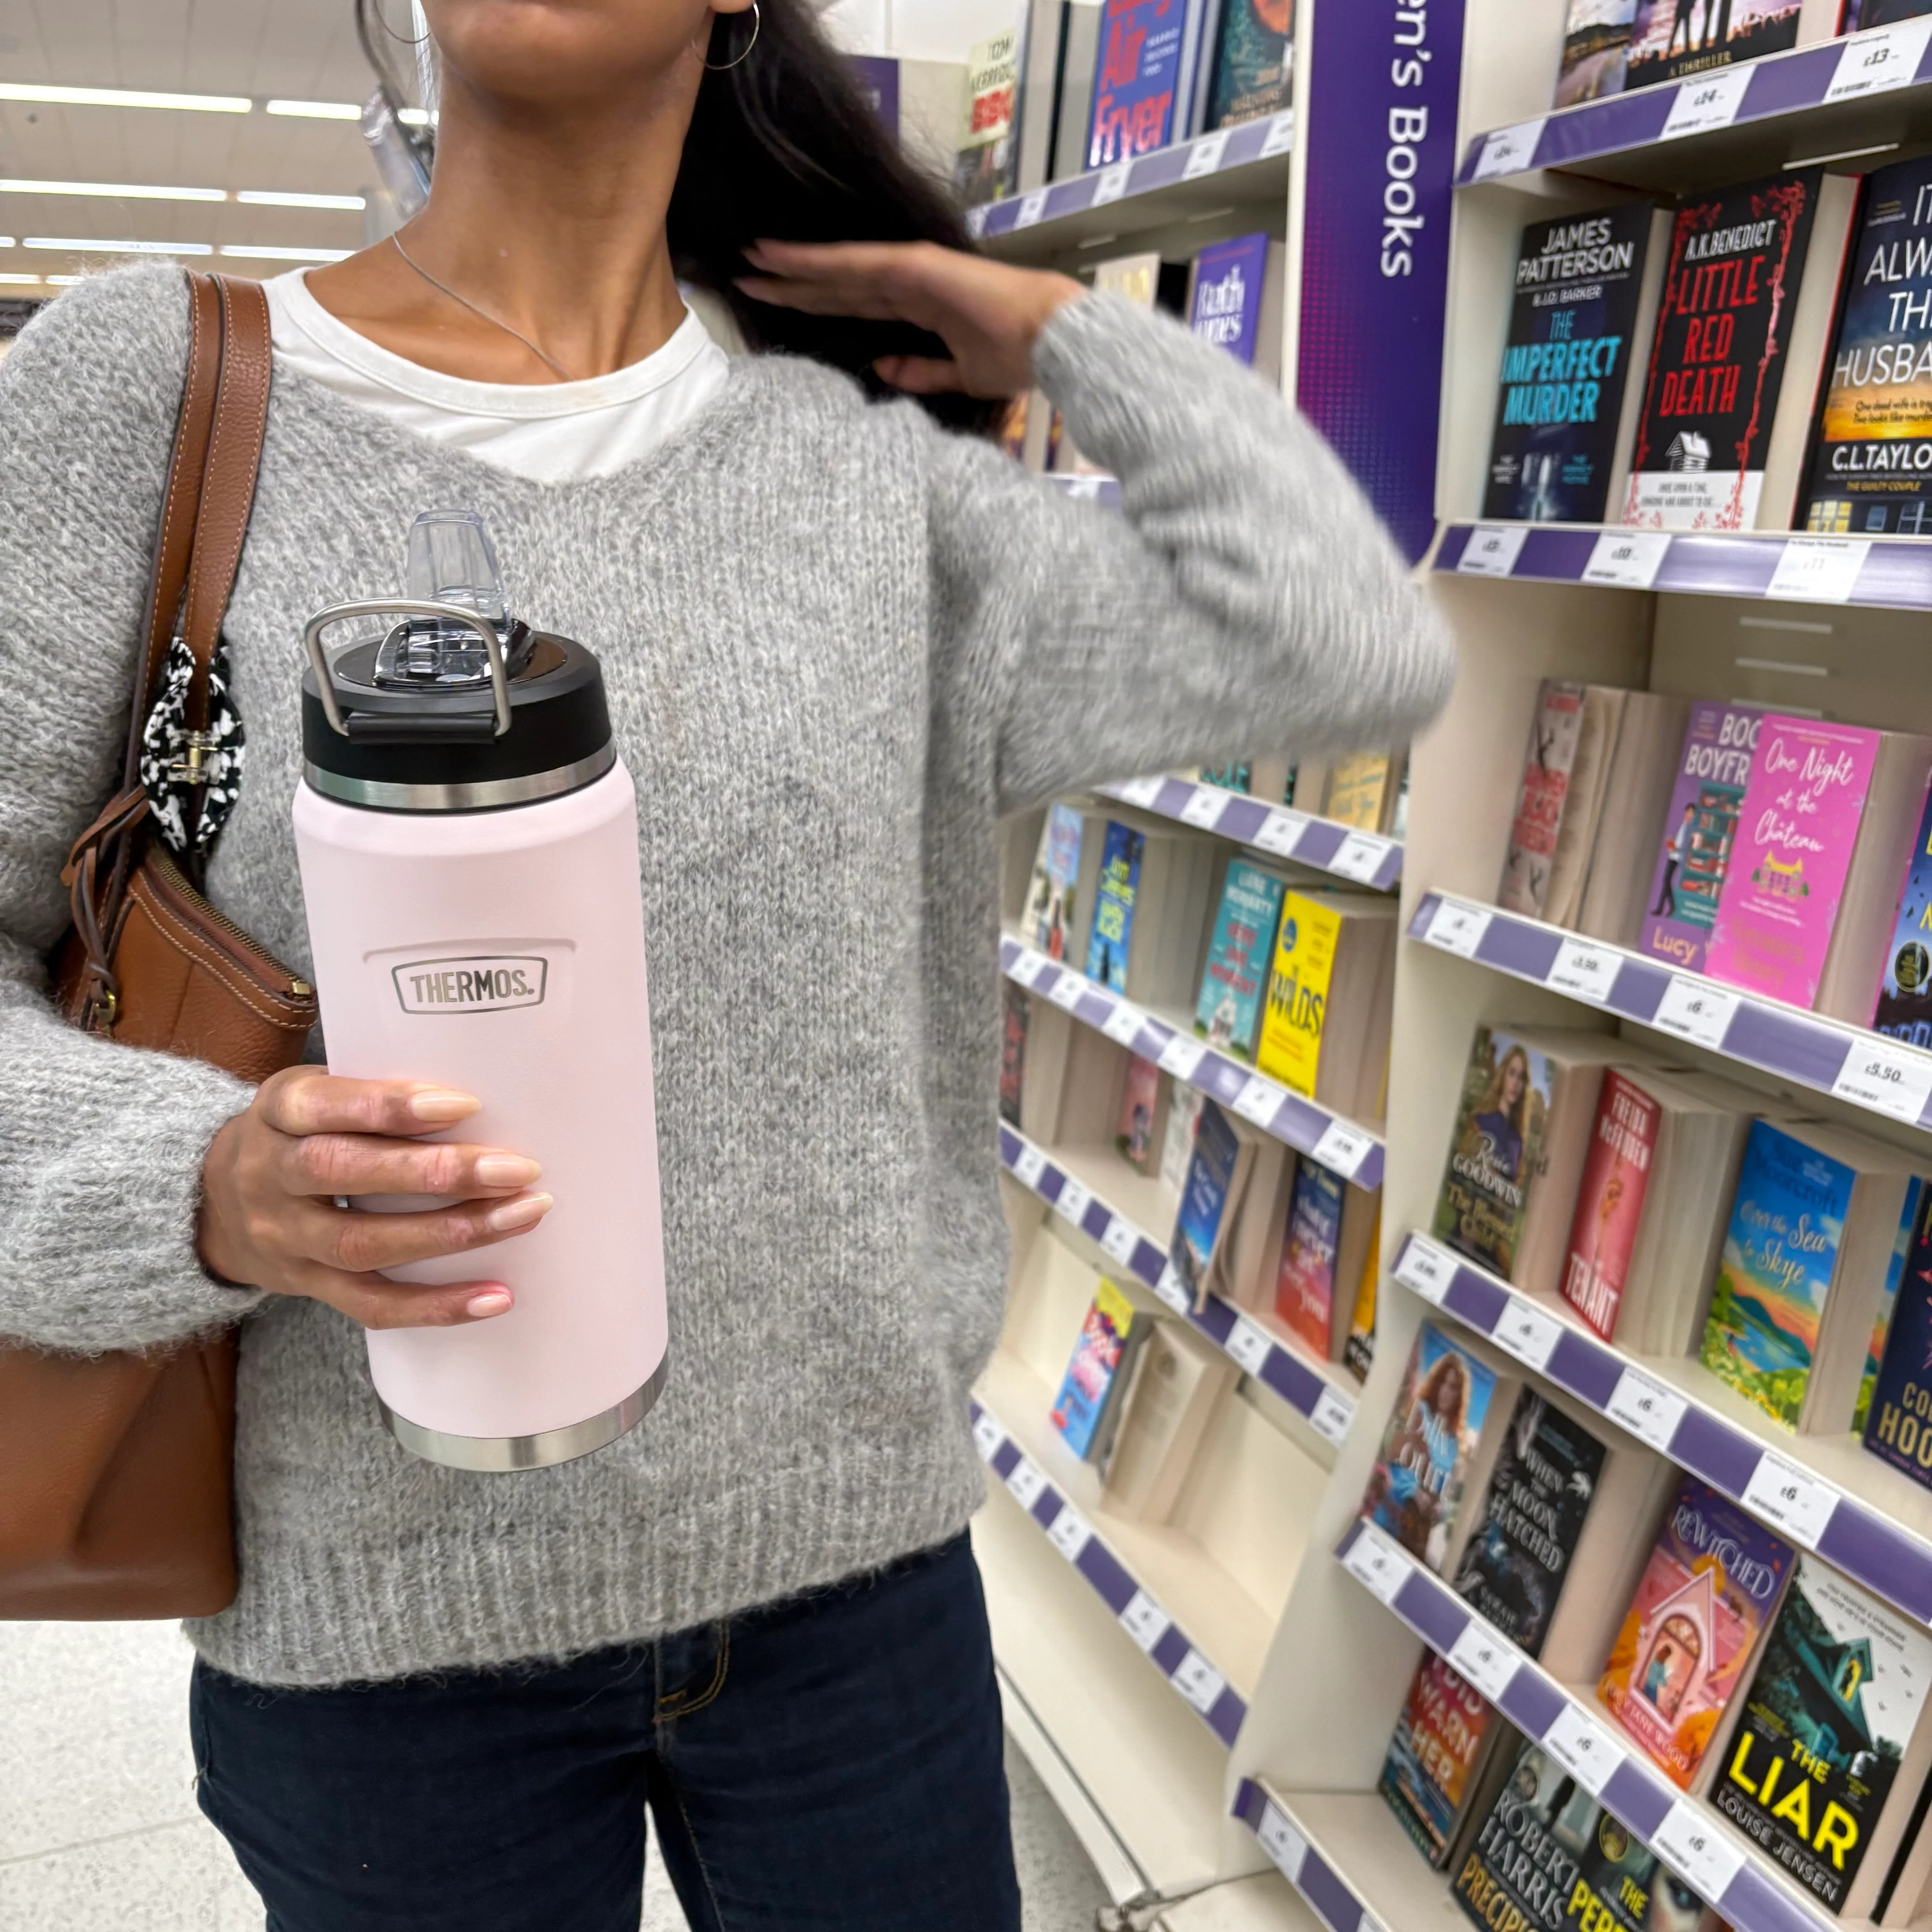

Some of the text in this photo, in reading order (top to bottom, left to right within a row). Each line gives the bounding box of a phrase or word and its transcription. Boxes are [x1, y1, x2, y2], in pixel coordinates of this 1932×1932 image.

[1100, 14, 1147, 92] Air
[1669, 51, 1732, 76] A THRILLER
[1864, 48, 1890, 67] £13
[1087, 89, 1171, 167] Fryer
[1380, 0, 1432, 278] n's Books
[1541, 217, 1613, 255] JAMES
[1516, 241, 1634, 284] PATTERSON
[1676, 255, 1766, 315] LITTLE
[1560, 284, 1603, 304] BARKER
[1889, 289, 1932, 332] TH
[1550, 310, 1575, 340] THE
[1682, 313, 1734, 364] RED
[1501, 336, 1623, 384] IMPERFECT
[1503, 381, 1600, 425] MURDER
[1659, 365, 1741, 417] DEATH
[1765, 738, 1854, 796] One Night
[1776, 788, 1817, 814] at the
[1652, 926, 1697, 965] Lucy
[1271, 970, 1323, 1039] WILDS
[1865, 1063, 1902, 1083] £5.50
[1611, 1092, 1647, 1137] FREIDA
[1453, 1153, 1522, 1208] GOODWIN
[1741, 1199, 1769, 1230] Over
[1788, 1213, 1826, 1253] Sea
[1756, 1238, 1804, 1290] Skye
[1565, 1251, 1618, 1334] TENANT
[1526, 1446, 1563, 1493] WHEN
[1780, 1485, 1798, 1501] £6
[1490, 1492, 1564, 1573] HATCHED
[1513, 1479, 1558, 1544] MOON
[1671, 1504, 1775, 1600] REWITCHED
[1417, 1670, 1480, 1766] WARN
[1630, 1705, 1654, 1733] JANE
[1655, 1729, 1691, 1771] WOOD
[1411, 1719, 1454, 1793] HER
[1791, 1739, 1831, 1785] THE
[1728, 1731, 1859, 1871] LIAR
[1495, 1790, 1578, 1894] ROBERT
[1717, 1788, 1774, 1846] LOUISE
[1772, 1842, 1840, 1902] JENSEN
[1479, 1816, 1568, 1931] HARRIS
[1619, 1876, 1649, 1919] THE
